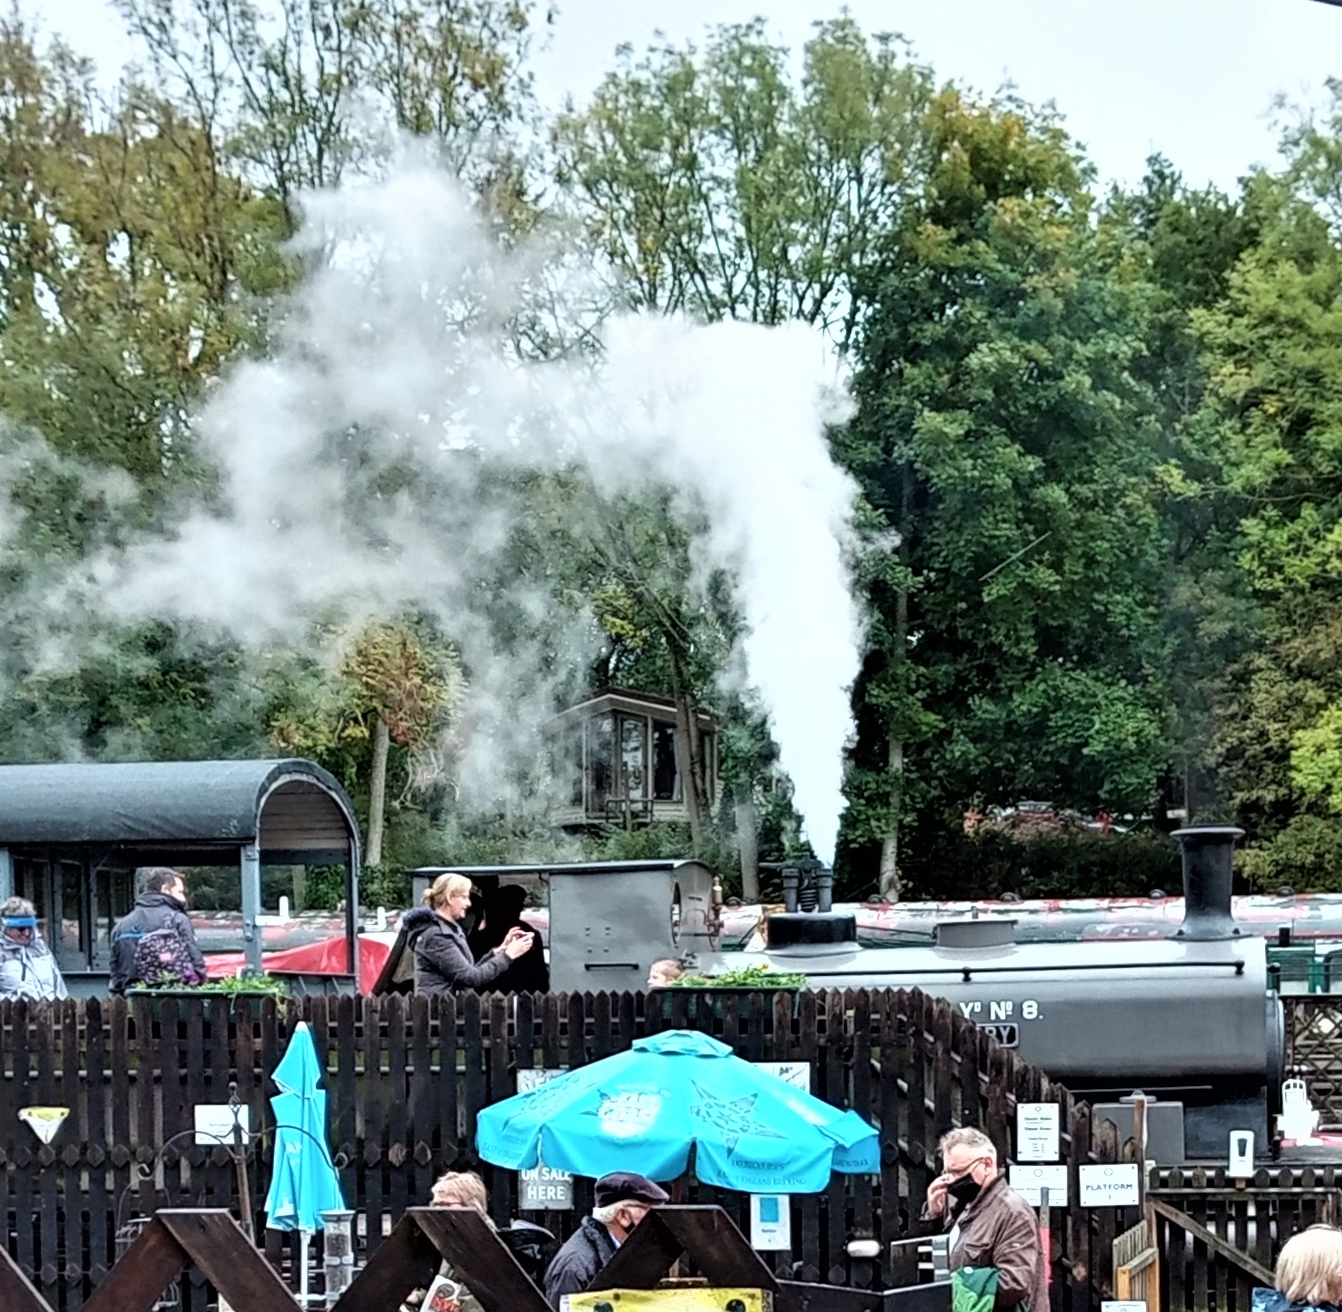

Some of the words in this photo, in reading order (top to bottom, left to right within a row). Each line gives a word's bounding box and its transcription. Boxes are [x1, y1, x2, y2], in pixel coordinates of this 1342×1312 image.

[521, 1168, 539, 1181] ON
[541, 1167, 571, 1181] SALE
[527, 1185, 566, 1200] HERE
[1085, 1183, 1133, 1191] PLATFORM
